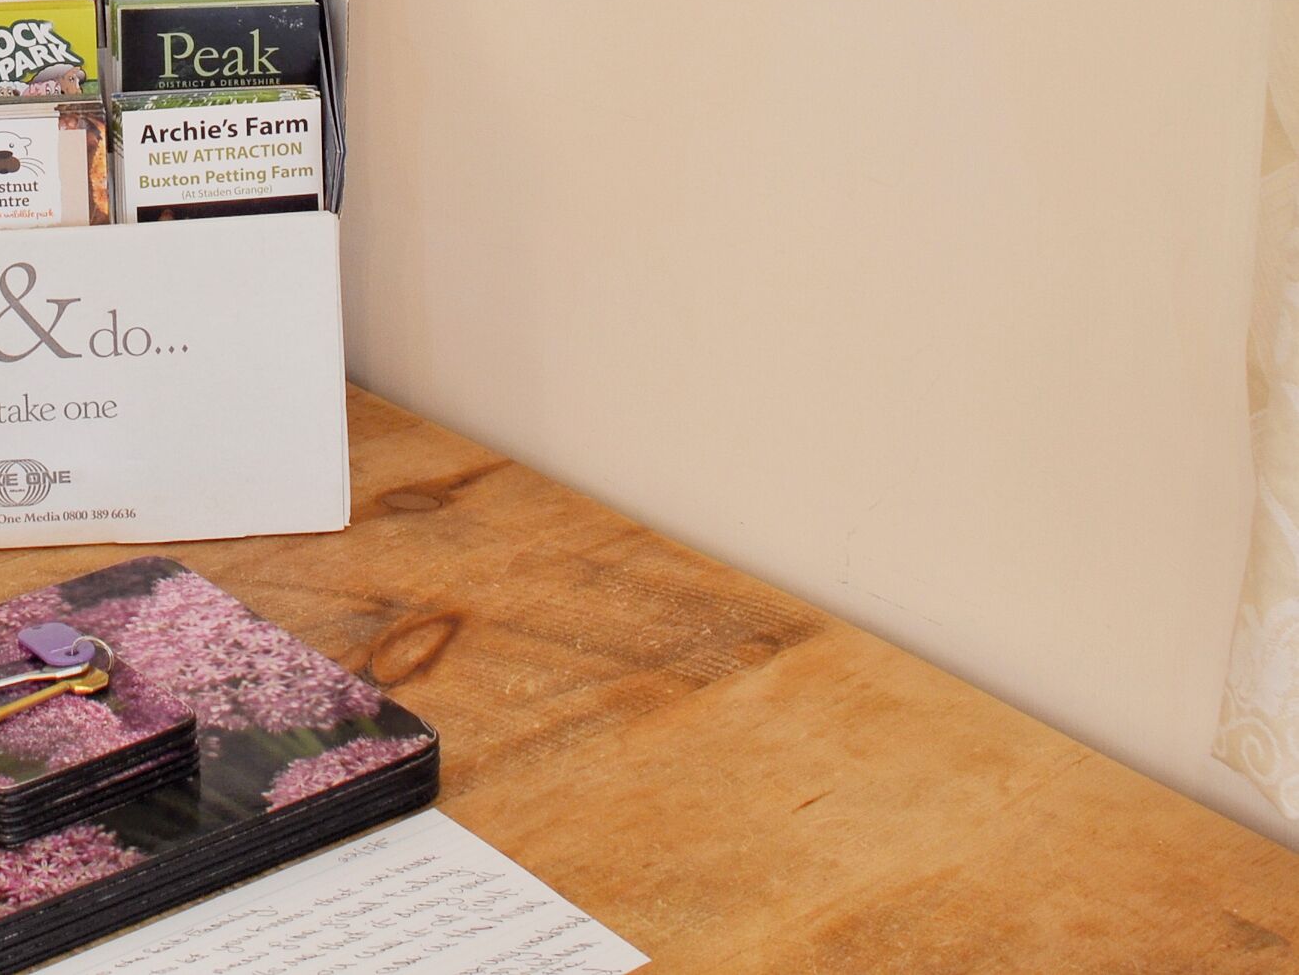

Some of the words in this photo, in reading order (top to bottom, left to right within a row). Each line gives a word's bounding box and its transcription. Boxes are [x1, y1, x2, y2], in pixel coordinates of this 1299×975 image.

[157, 29, 282, 78] Peak
[158, 79, 205, 89] DISTRICT
[210, 79, 216, 88] &
[221, 77, 281, 87] DERBYSHIRE
[141, 118, 238, 144] Archie's
[246, 117, 309, 136] Farm
[148, 150, 188, 166] NEW
[193, 141, 303, 163] ATTRACTION
[139, 173, 200, 189] Buxton
[205, 167, 267, 186] Petting
[272, 164, 314, 179] Farm
[181, 190, 197, 200] (At
[199, 187, 232, 198] Staden
[233, 185, 273, 197] Grange)
[3, 209, 35, 219] wildlife
[36, 209, 54, 220] park
[89, 309, 190, 359] do...
[63, 397, 118, 421] one
[26, 470, 72, 486] ONE
[24, 511, 60, 523] Media
[63, 510, 88, 521] 0800
[91, 509, 109, 520] 389
[111, 507, 137, 519] 6636
